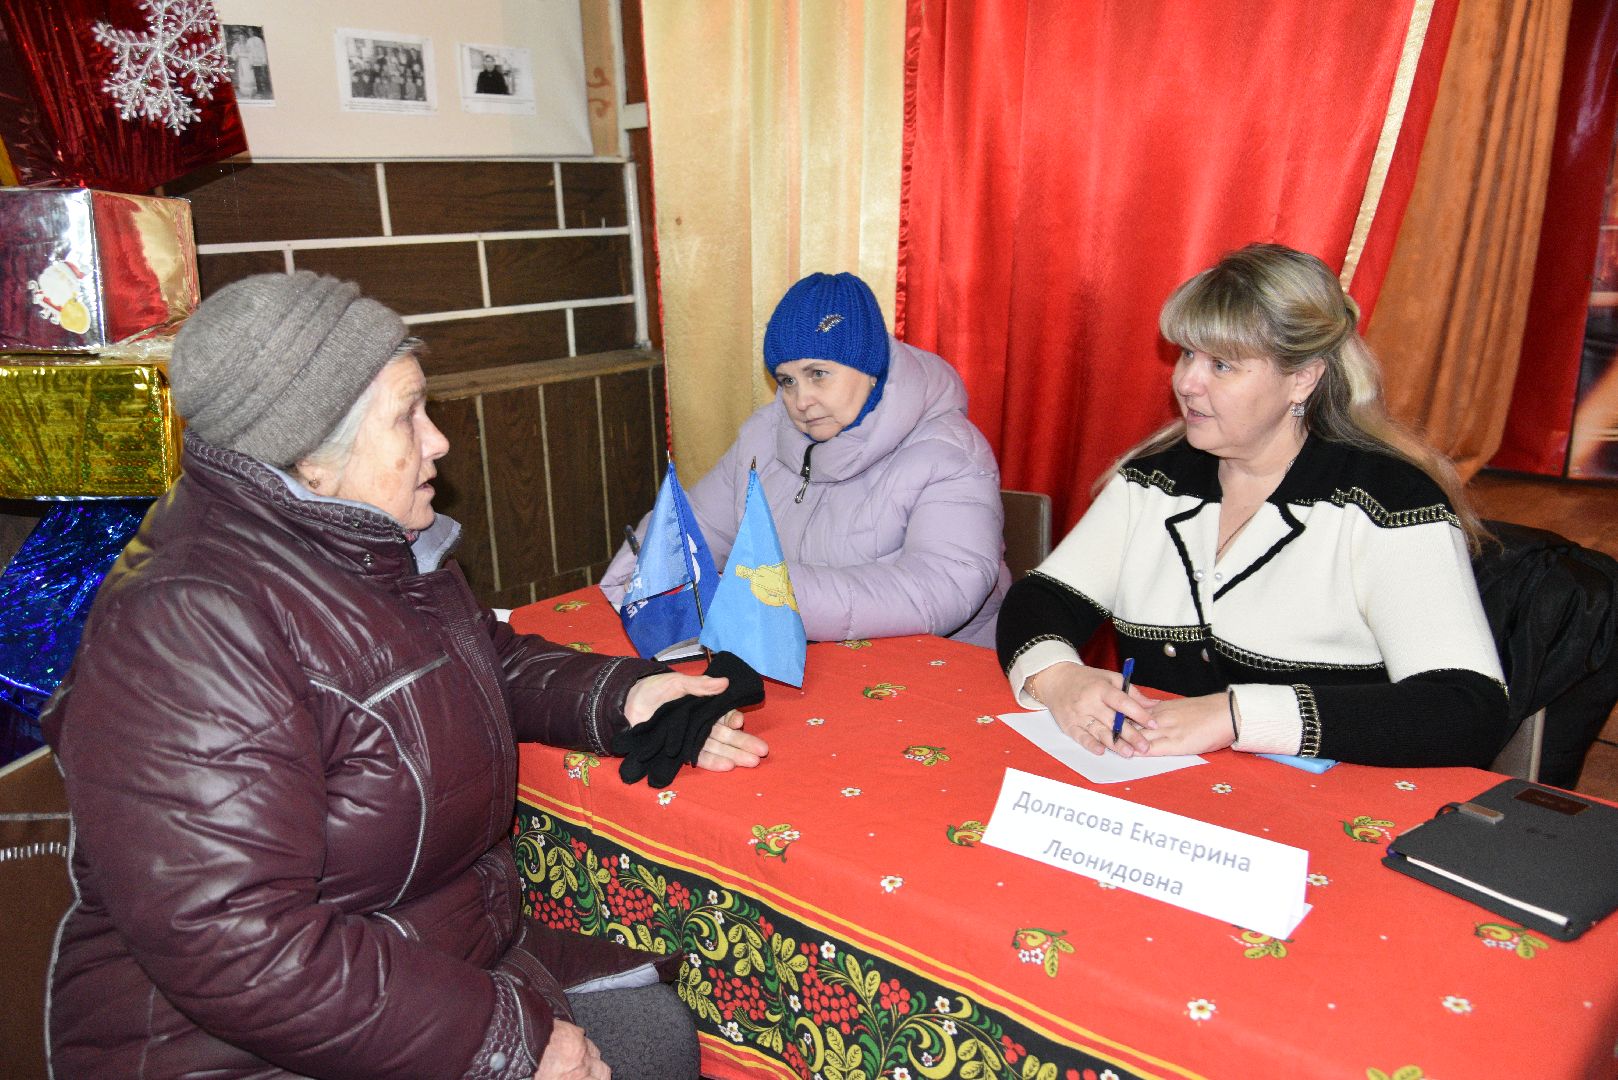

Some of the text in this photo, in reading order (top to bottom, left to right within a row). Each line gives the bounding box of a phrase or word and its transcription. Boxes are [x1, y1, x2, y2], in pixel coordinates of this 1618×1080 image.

[1012, 790, 1251, 873] Долгасова Екатерина
[1042, 839, 1183, 896] Леонидовна
